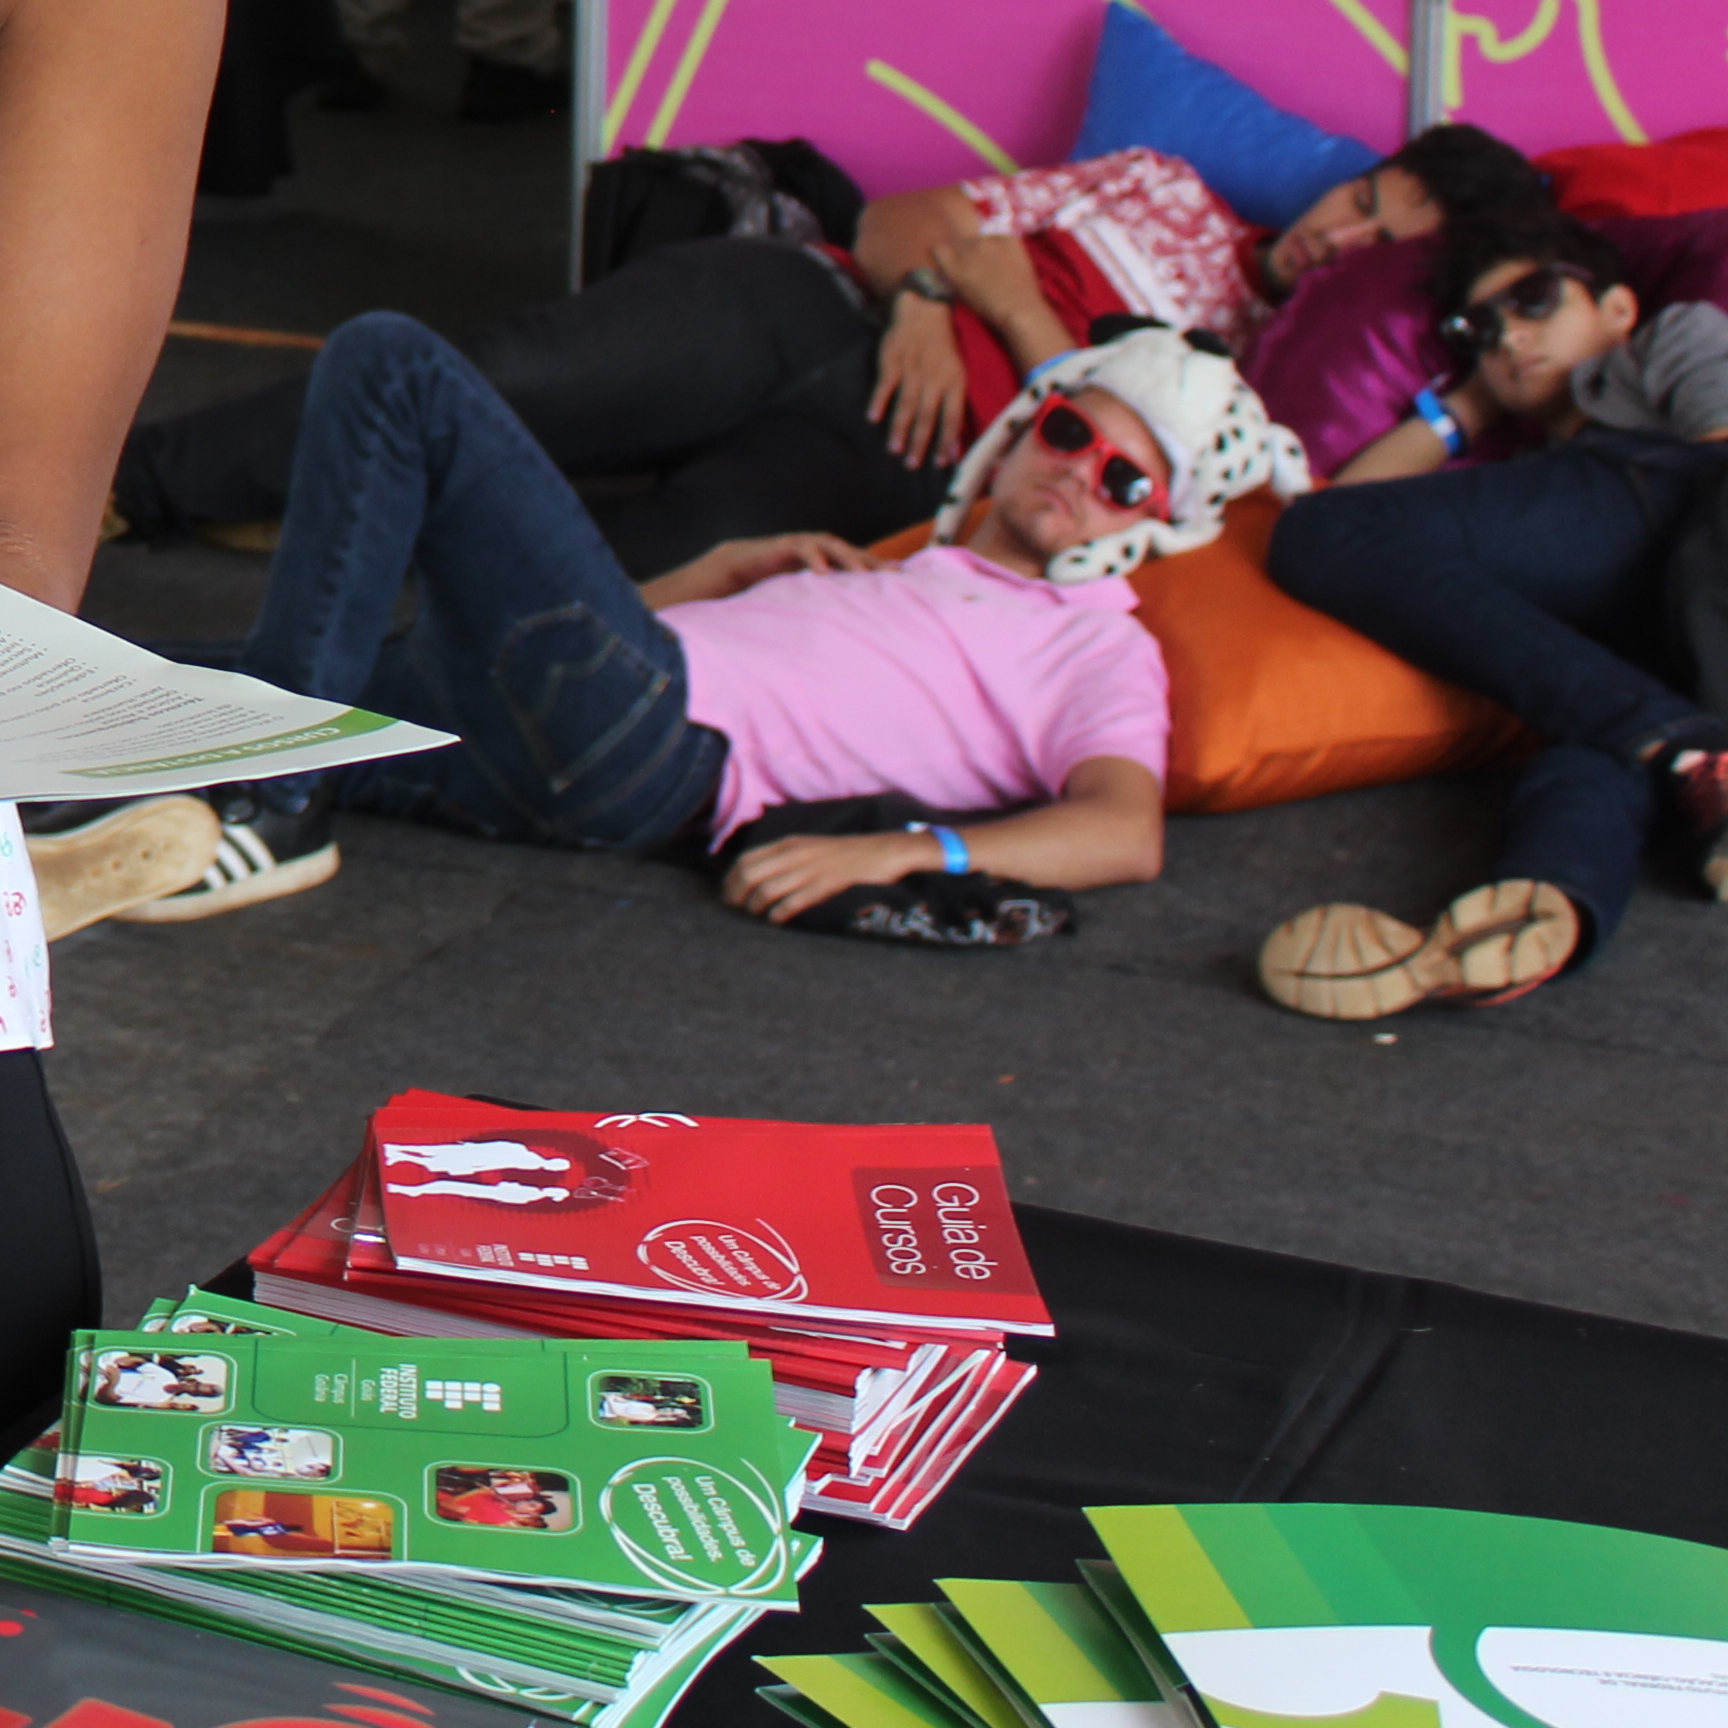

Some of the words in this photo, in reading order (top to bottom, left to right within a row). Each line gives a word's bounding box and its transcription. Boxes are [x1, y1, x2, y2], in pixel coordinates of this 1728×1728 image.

[7, 685, 23, 693] no
[23, 657, 77, 686] Ofertados
[35, 669, 95, 697] Edificações
[37, 663, 84, 688] Química
[77, 676, 127, 697] Ofertado
[243, 727, 340, 751] CURSOS
[870, 1184, 926, 1274] Cursos
[932, 1182, 987, 1244] Guia
[663, 1240, 726, 1286] Descubra!
[717, 1234, 739, 1250] Um
[763, 1280, 782, 1291] de
[949, 1248, 999, 1280] de
[379, 1367, 398, 1413] FEDERAL
[398, 1363, 417, 1419] INSTITUTO
[632, 1483, 694, 1561] Descubra!
[695, 1475, 718, 1496] Um
[707, 1497, 746, 1547] Câmpus
[735, 1548, 757, 1567] de
